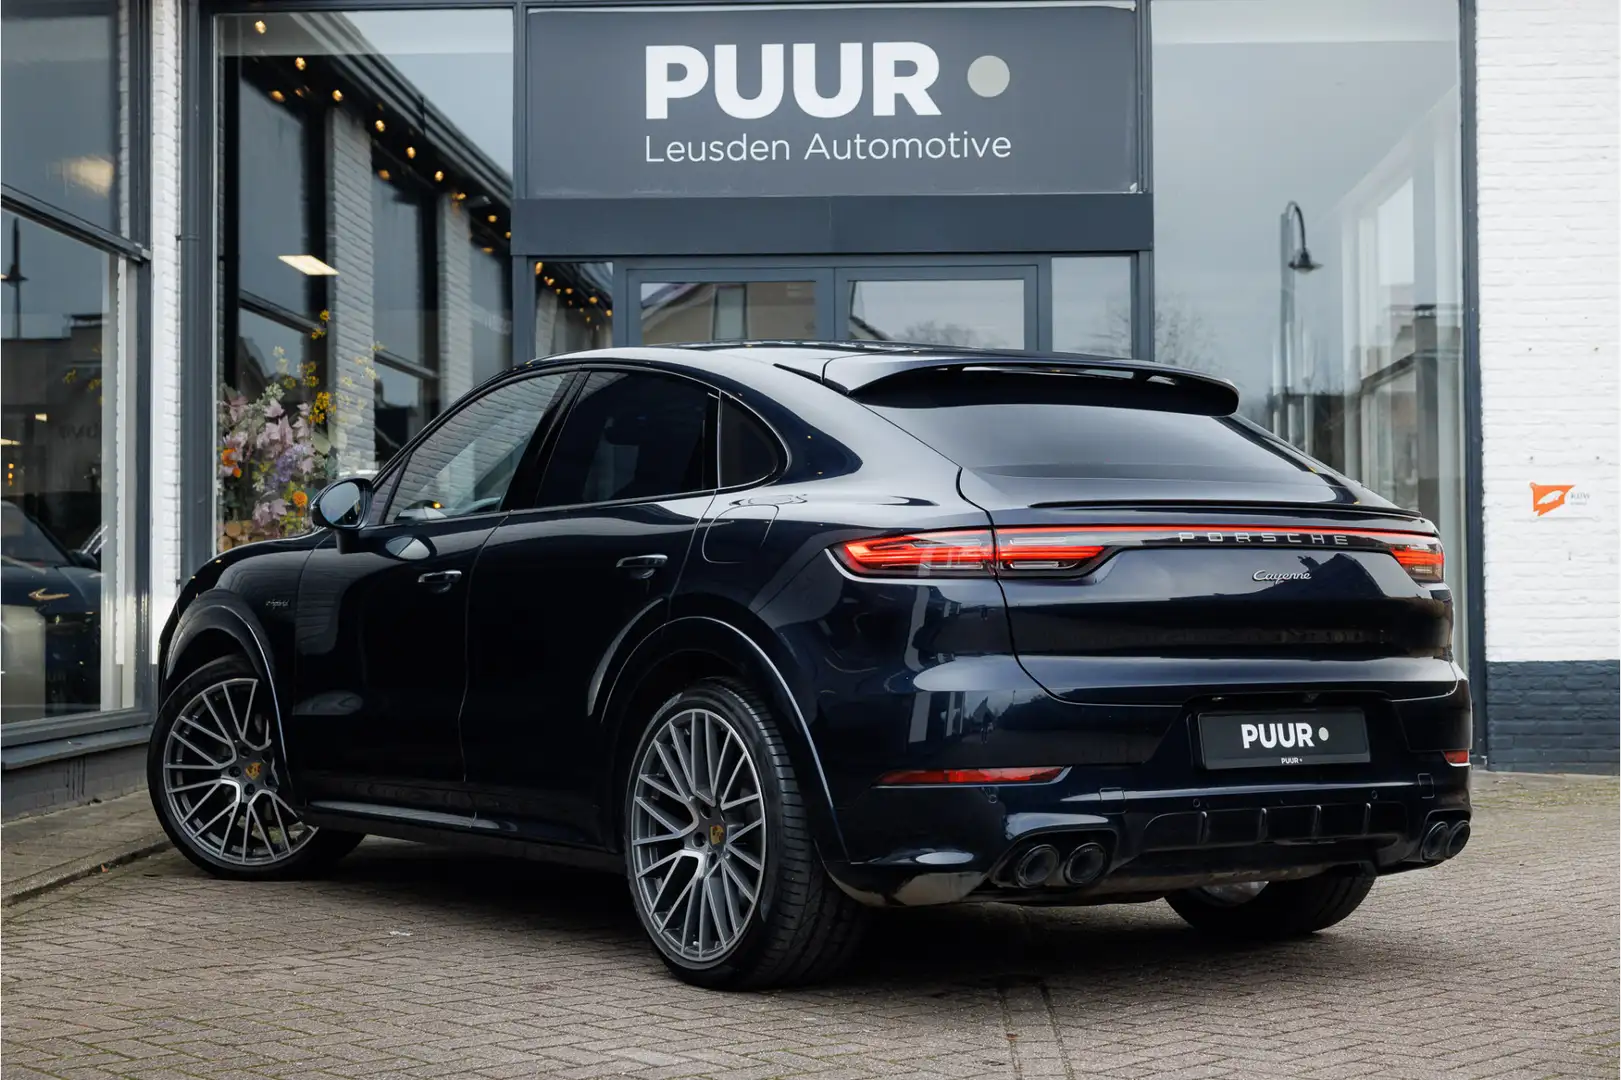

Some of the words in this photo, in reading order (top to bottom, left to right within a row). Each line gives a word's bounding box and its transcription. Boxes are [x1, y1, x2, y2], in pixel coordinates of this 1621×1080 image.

[646, 42, 942, 119] PUUR
[645, 133, 790, 162] Leusden
[804, 130, 1011, 160] Automotive
[1178, 532, 1348, 545] PORSCHE
[1252, 569, 1312, 585] Cayenne
[1241, 722, 1315, 749] PUUR
